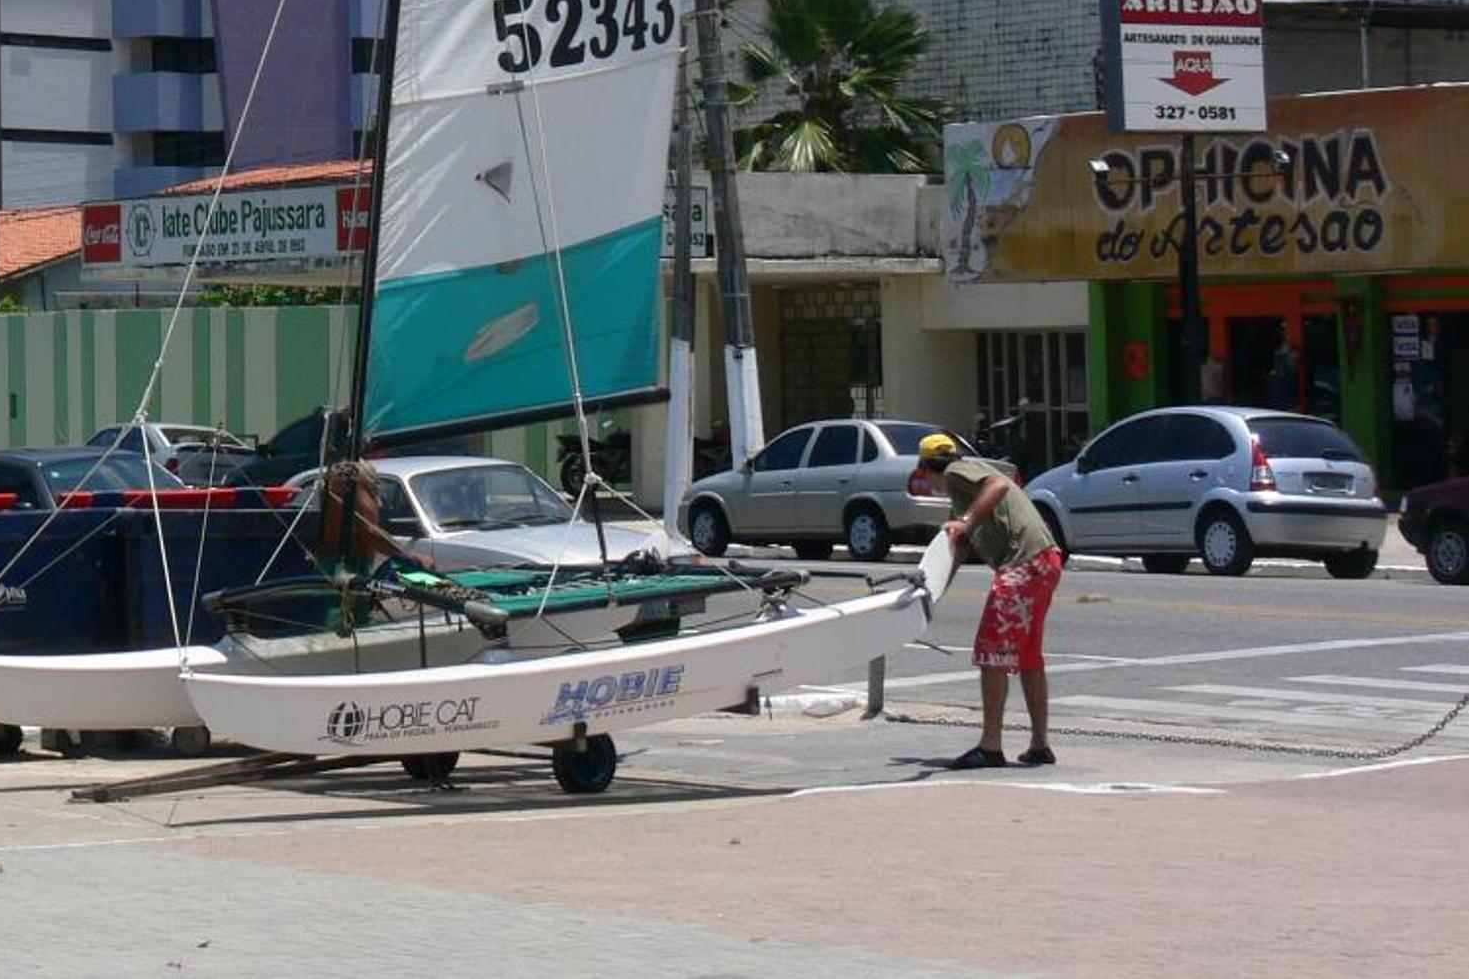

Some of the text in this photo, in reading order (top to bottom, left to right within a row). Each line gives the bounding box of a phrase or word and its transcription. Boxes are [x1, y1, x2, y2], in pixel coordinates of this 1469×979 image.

[1095, 135, 1387, 210] OPHICINA
[162, 205, 191, 238] Iate
[193, 199, 238, 236] Clube
[241, 199, 326, 238] Pajussara
[1096, 219, 1145, 262] do
[554, 664, 684, 711] HOBIE
[367, 697, 481, 731] HOBIE CAT
